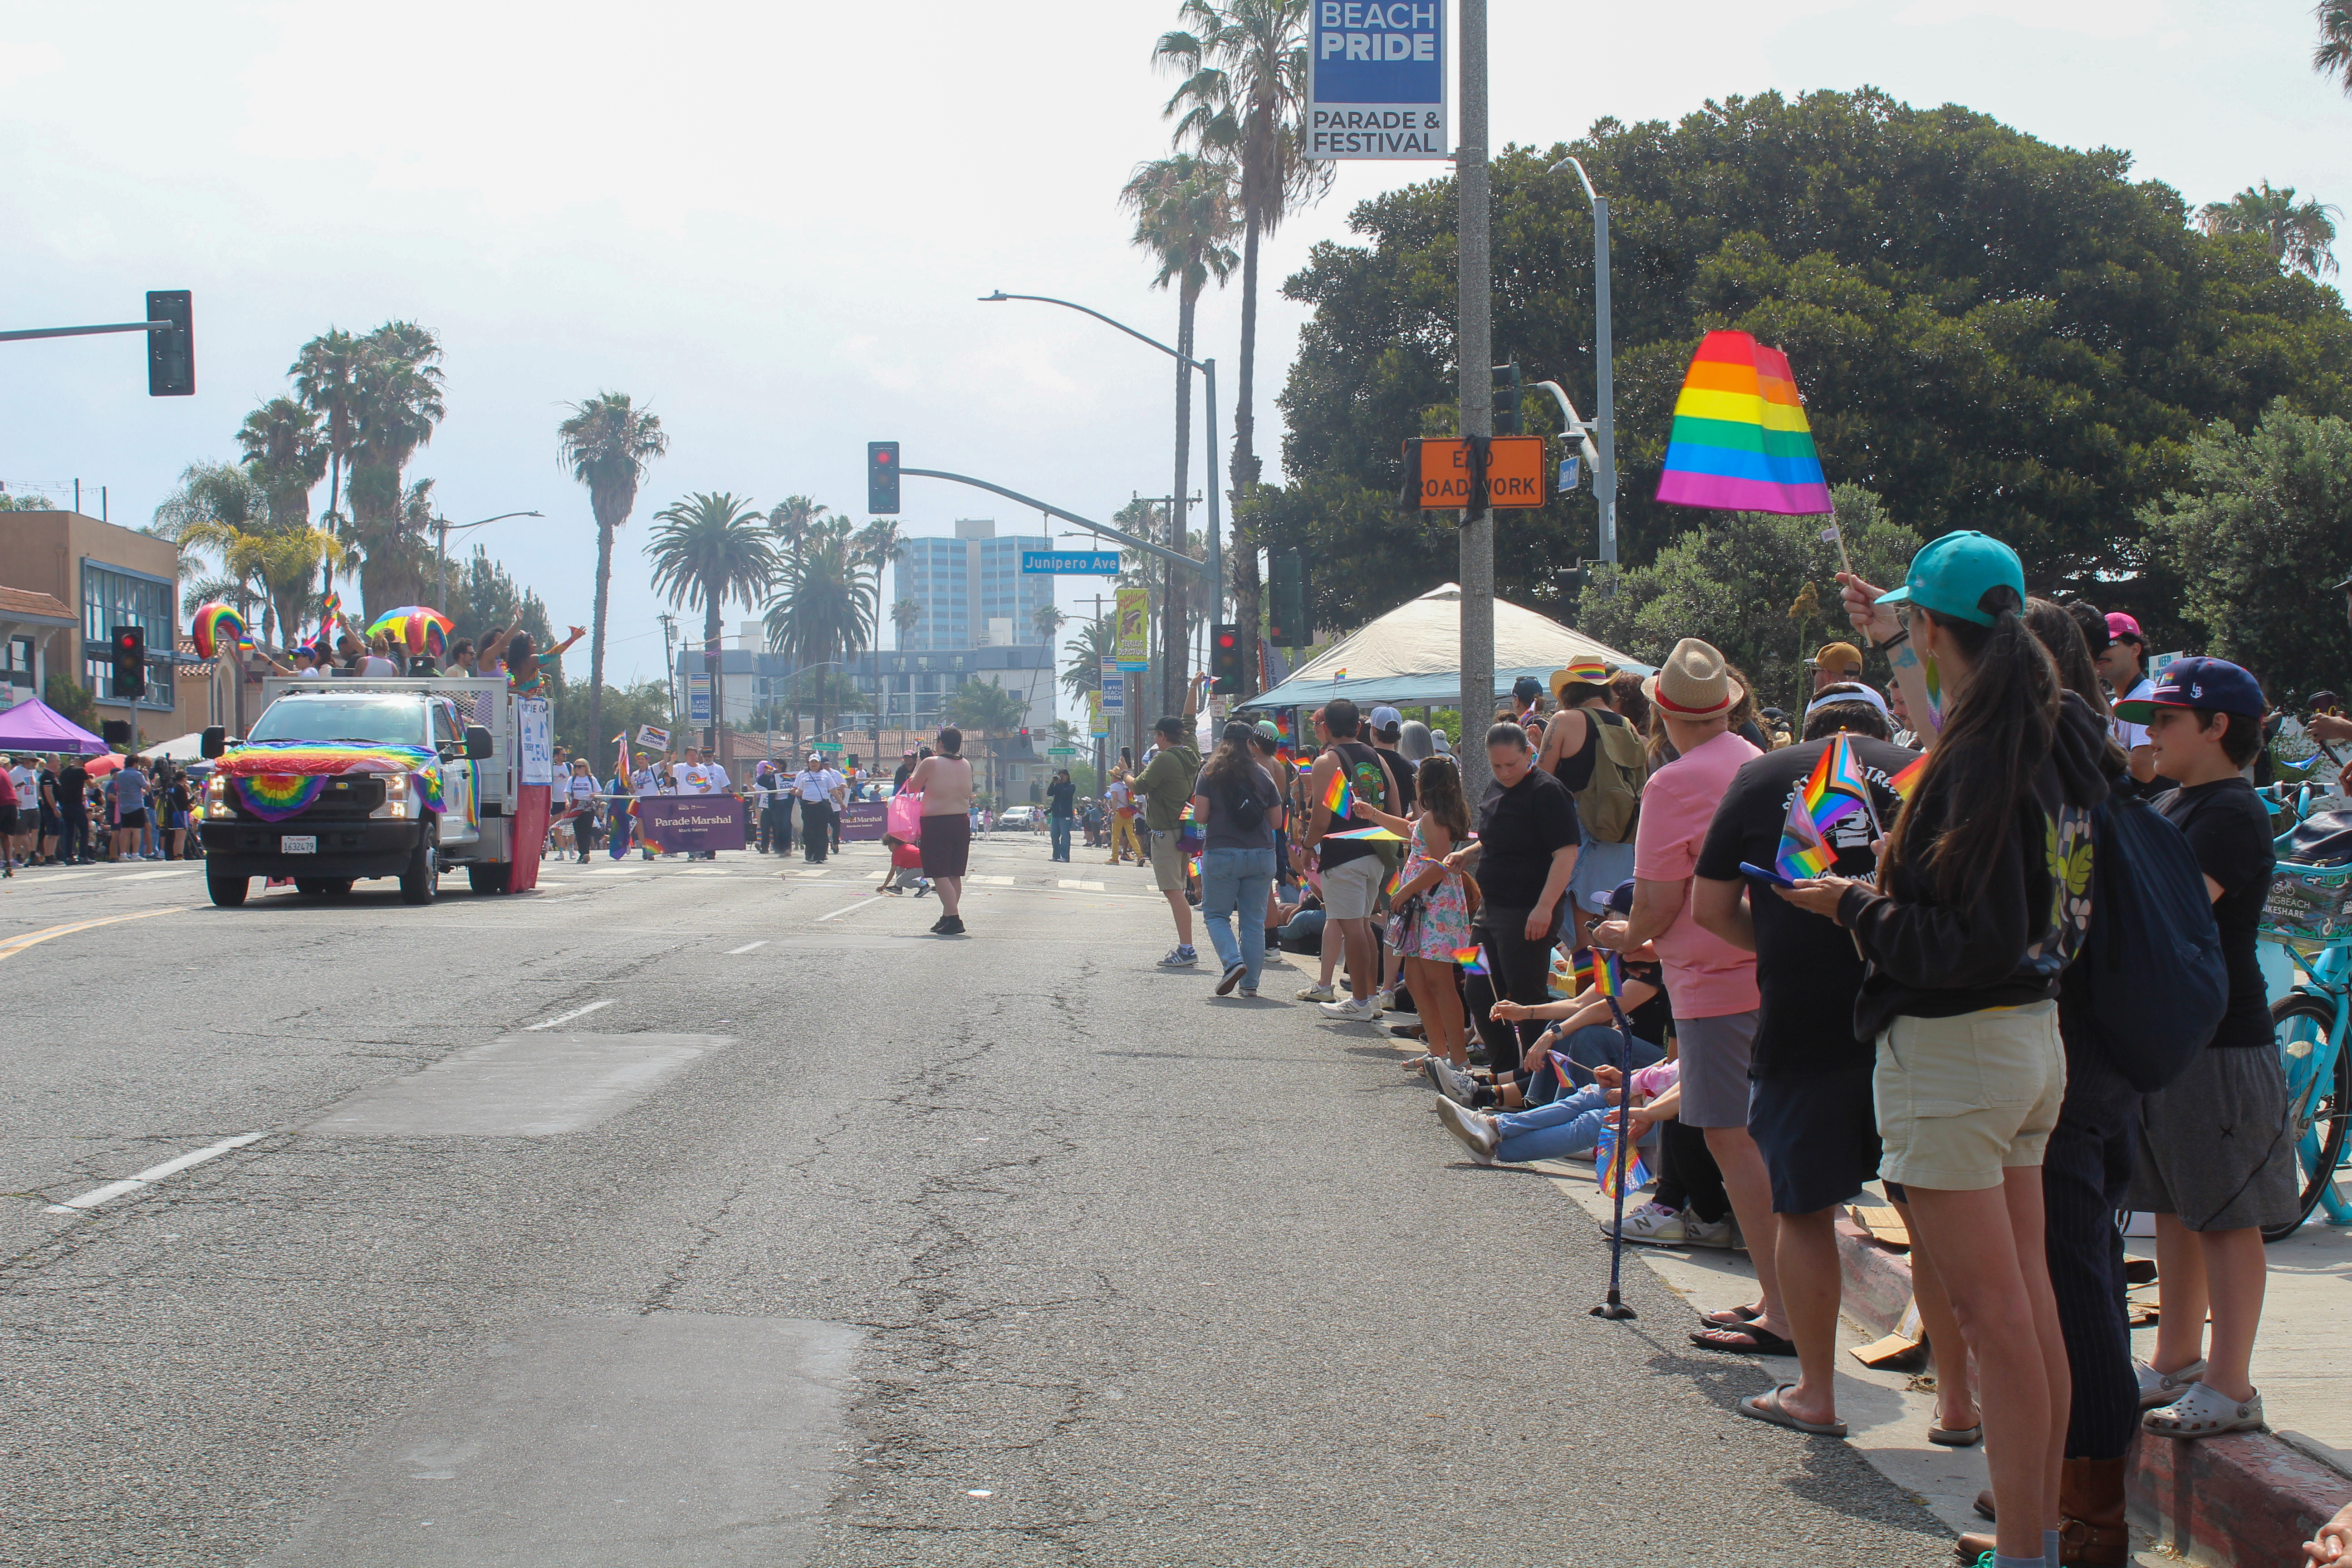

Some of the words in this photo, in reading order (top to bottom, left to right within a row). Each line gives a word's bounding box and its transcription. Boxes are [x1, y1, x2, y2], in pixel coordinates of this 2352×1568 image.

[1322, 3, 1434, 29] BEACH
[1321, 32, 1434, 61] PRIDE
[1313, 111, 1416, 129] PARADE
[1424, 111, 1440, 129] &
[1313, 132, 1437, 153] FESTIVAL
[1453, 450, 1494, 468] ED
[1420, 479, 1469, 497] OAD
[1025, 556, 1087, 571] Junipero
[1092, 557, 1117, 569] Ave
[1117, 647, 1147, 656] DEPICTIONS
[641, 736, 663, 746] RAMOS
[654, 816, 690, 827] Parade
[691, 815, 732, 825] Marshal
[284, 842, 314, 851] 1632479
[2267, 895, 2310, 909] NGBEACH
